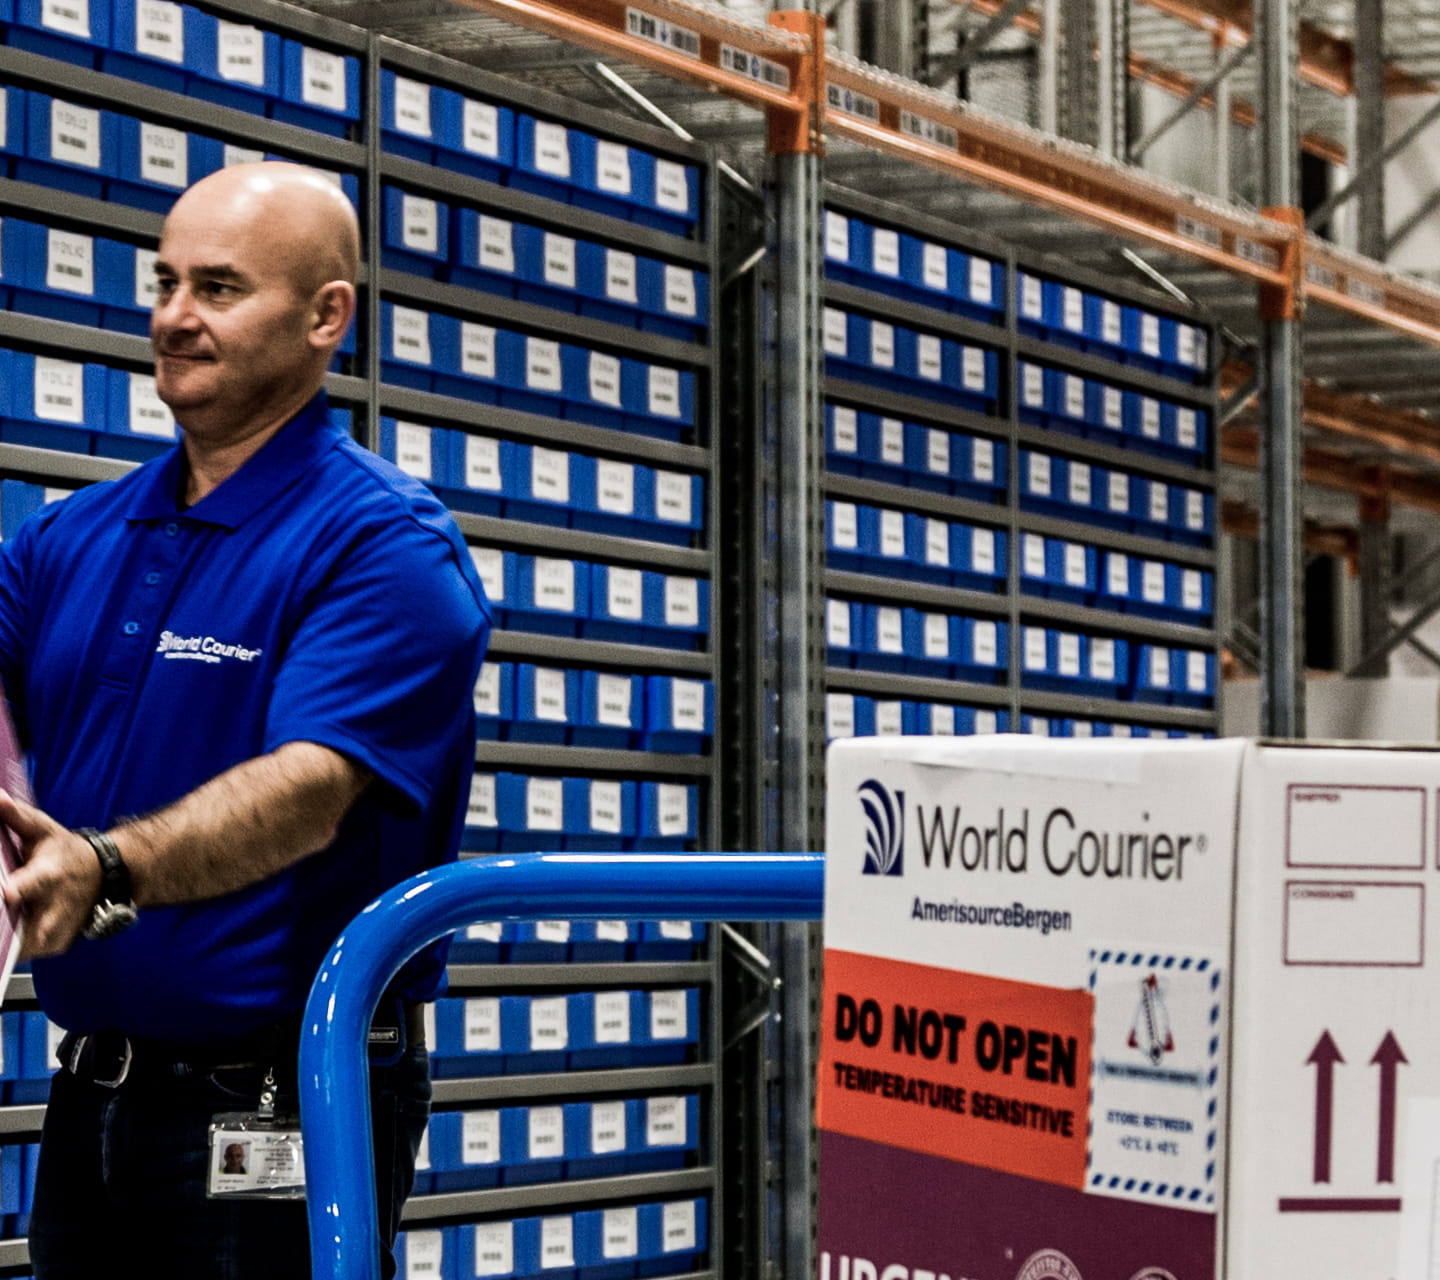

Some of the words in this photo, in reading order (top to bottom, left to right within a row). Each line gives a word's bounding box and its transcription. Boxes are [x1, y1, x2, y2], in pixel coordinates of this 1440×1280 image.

[917, 805, 1028, 874] World
[911, 896, 1073, 935] AmerisourceBergen
[834, 992, 883, 1047] DO
[893, 1004, 966, 1064] NOT
[975, 1020, 1078, 1087] OPEN
[833, 1061, 966, 1115] TEMPERATURE
[970, 1092, 1076, 1138] SENSITIVE
